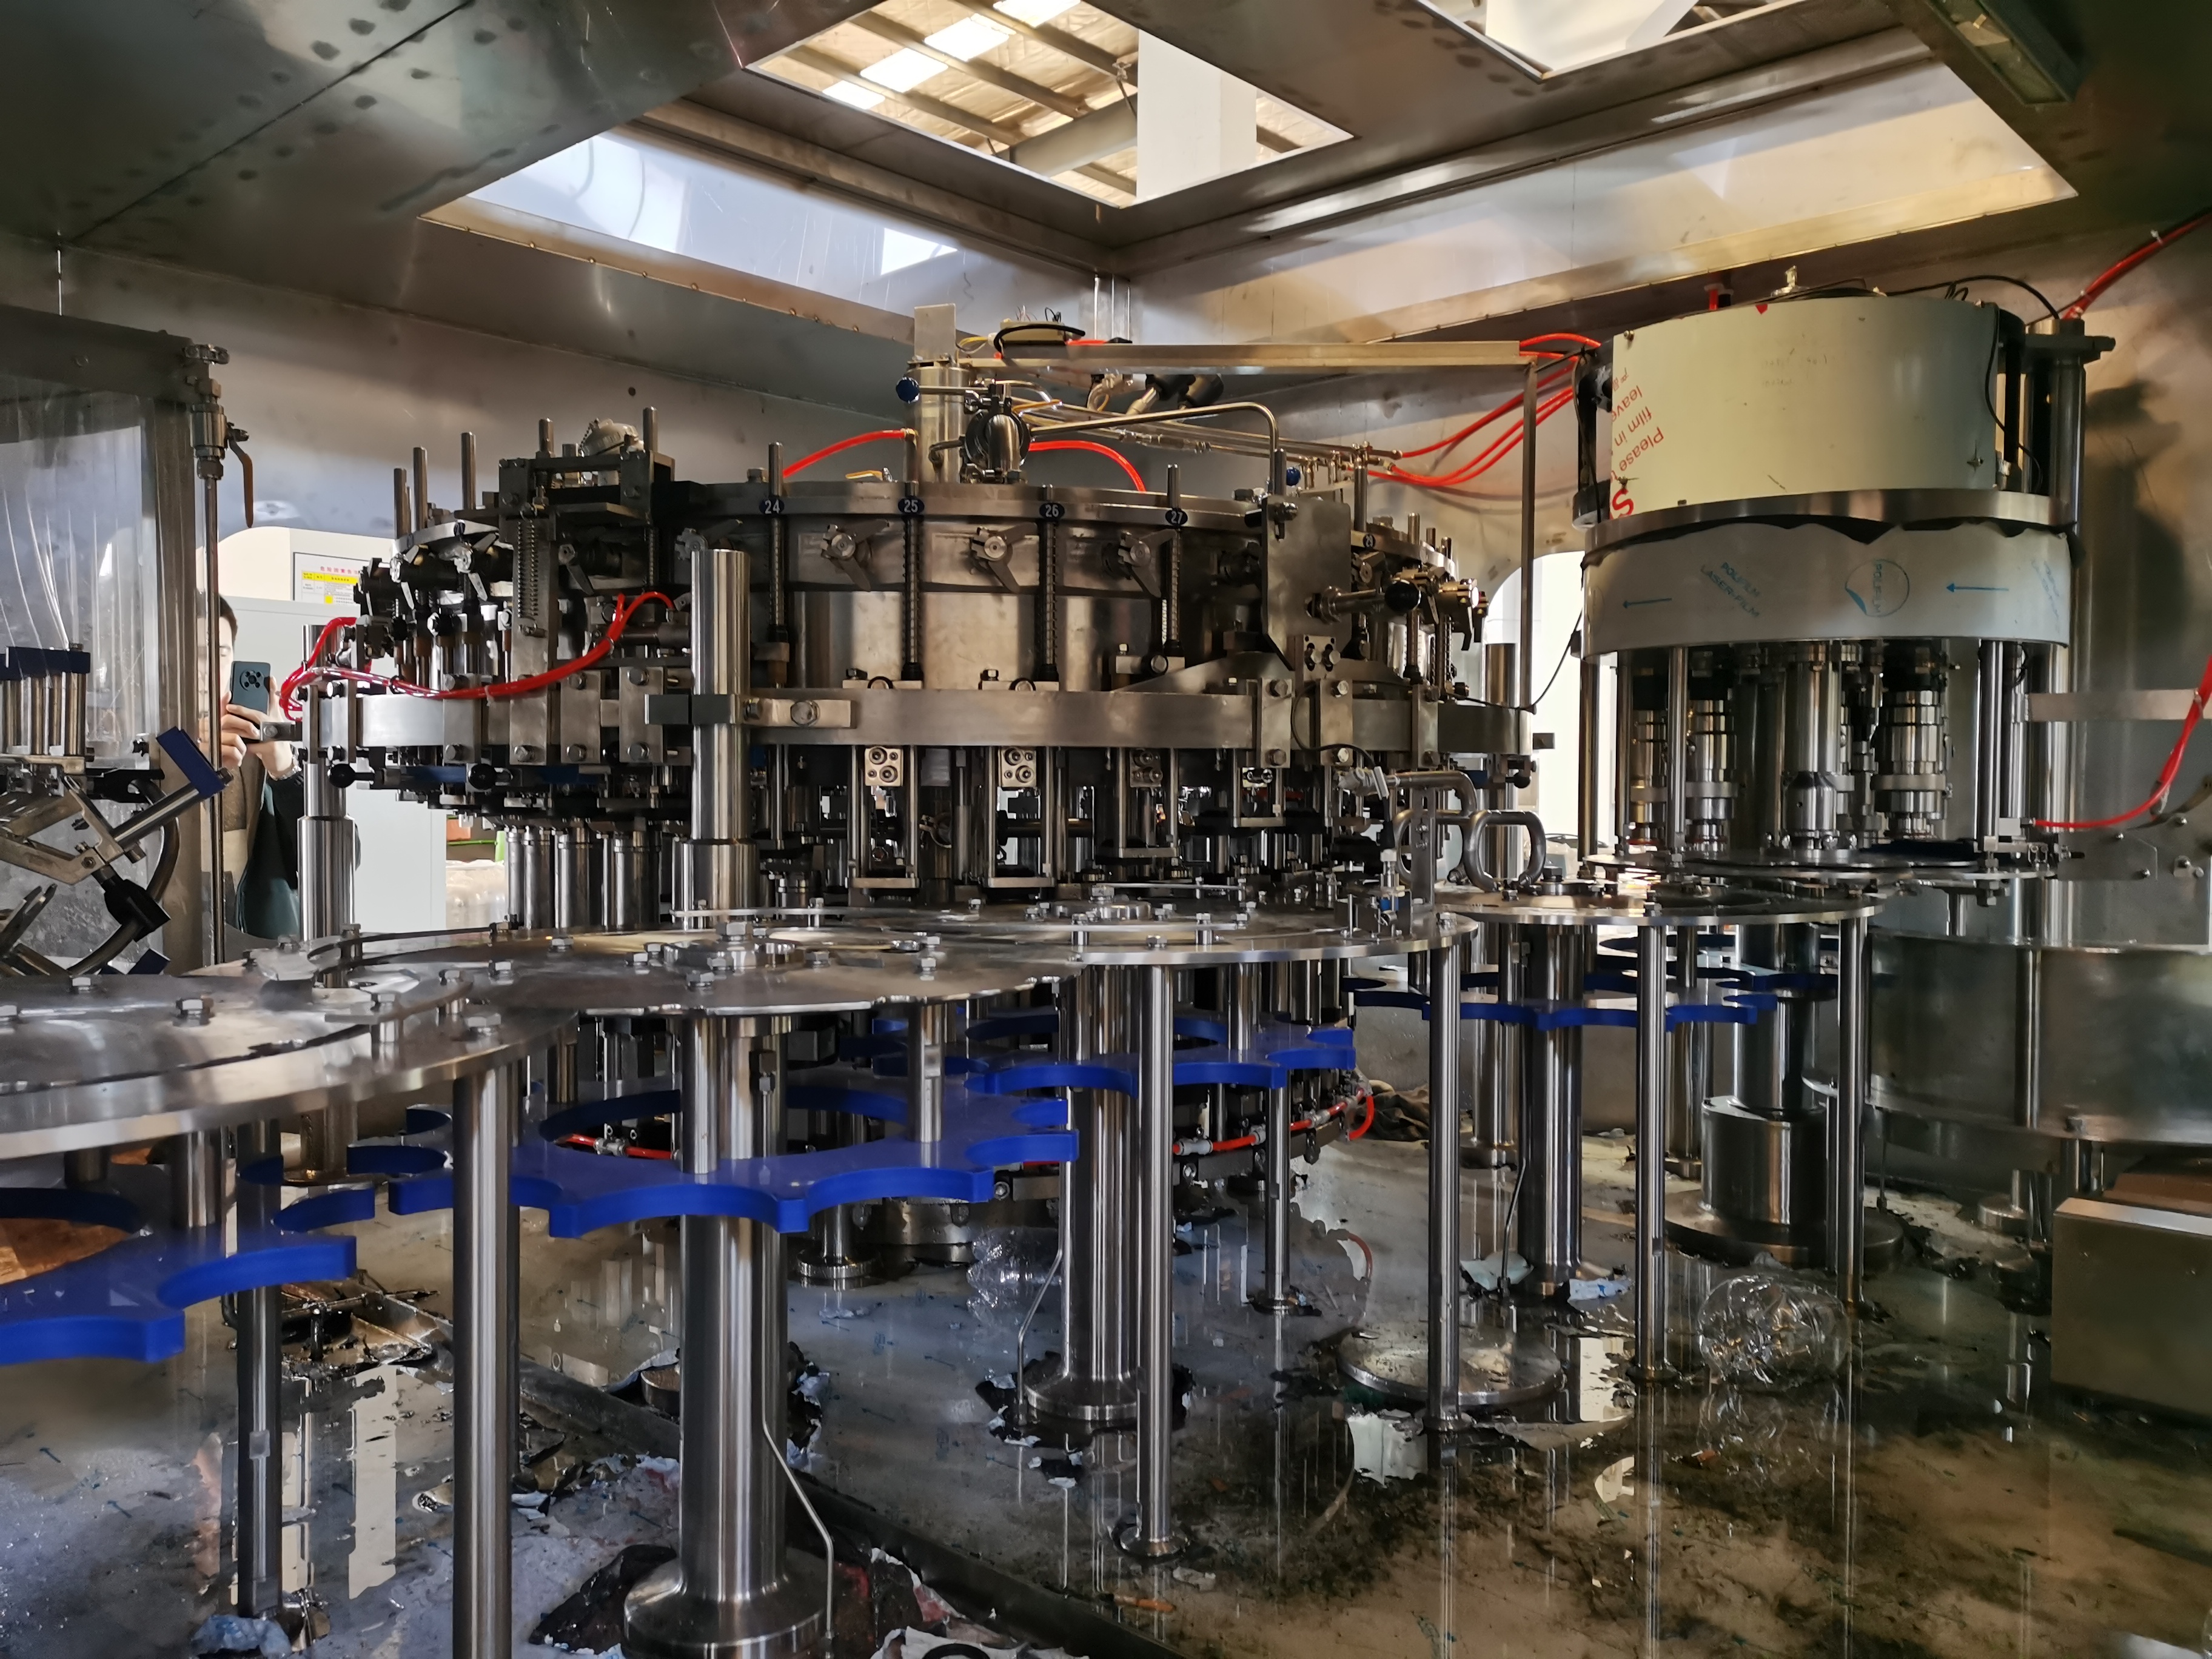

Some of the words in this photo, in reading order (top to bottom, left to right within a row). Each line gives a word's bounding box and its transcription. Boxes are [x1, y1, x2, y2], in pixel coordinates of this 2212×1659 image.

[1610, 385, 1643, 423] leave
[1627, 406, 1652, 433] film
[1614, 431, 1628, 447] in
[1619, 426, 1664, 472] Please
[765, 499, 780, 514] 24
[904, 499, 918, 513] 25
[1045, 504, 1059, 517] 26
[1171, 511, 1183, 525] 27
